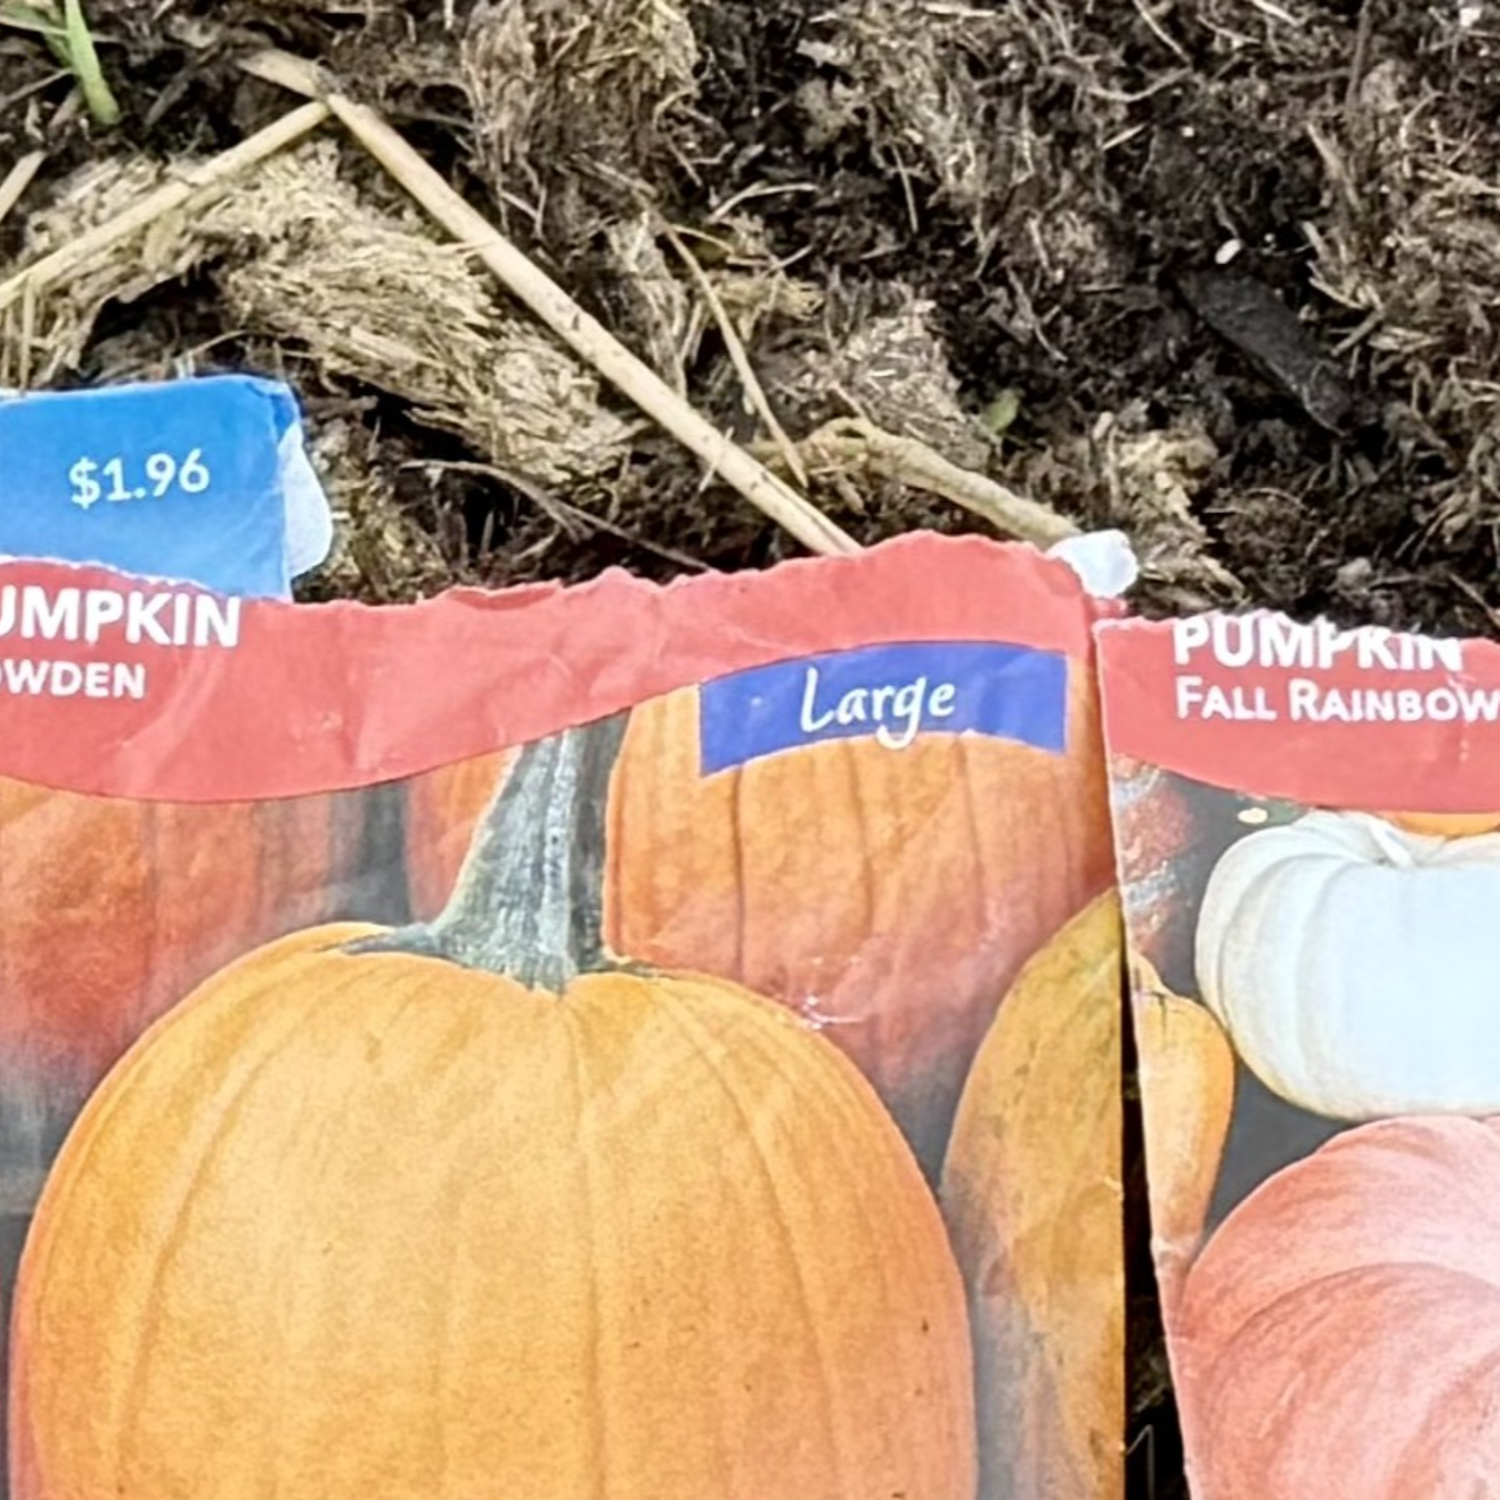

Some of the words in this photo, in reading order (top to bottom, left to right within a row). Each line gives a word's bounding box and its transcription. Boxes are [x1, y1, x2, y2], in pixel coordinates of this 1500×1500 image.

[67, 449, 211, 510] $1.96
[1172, 608, 1463, 672] PUMPKIN
[800, 667, 957, 752] Large
